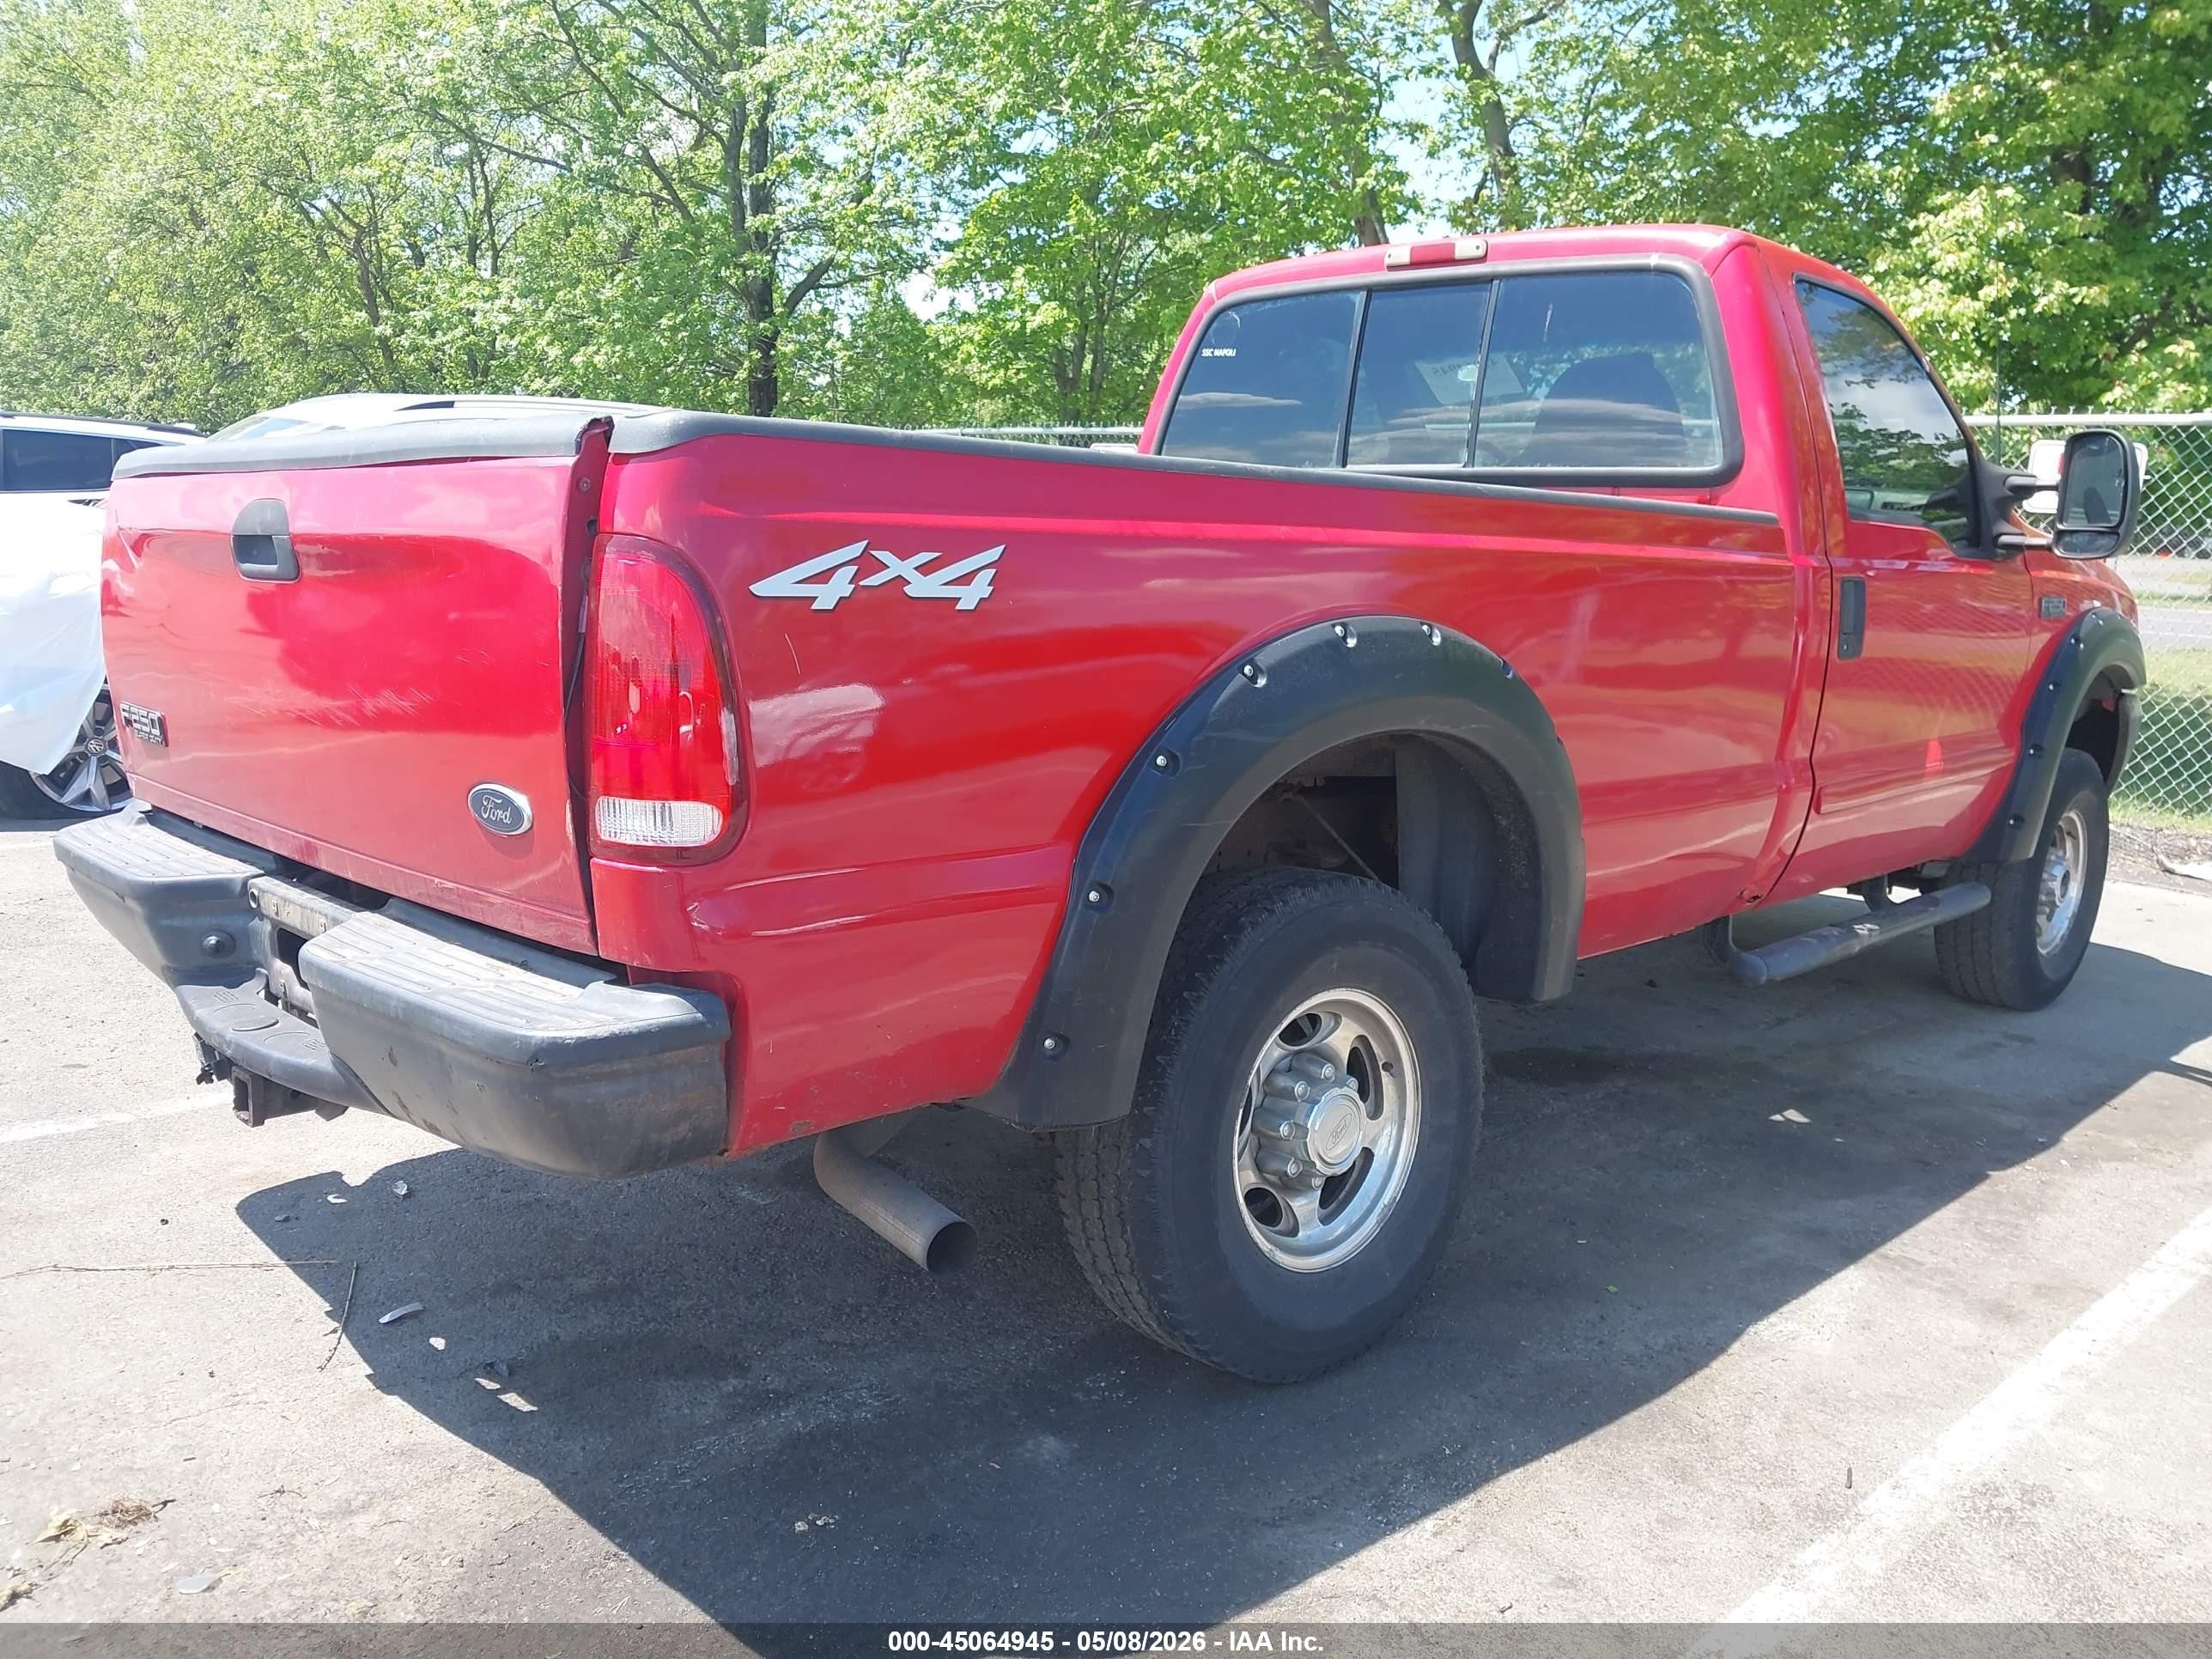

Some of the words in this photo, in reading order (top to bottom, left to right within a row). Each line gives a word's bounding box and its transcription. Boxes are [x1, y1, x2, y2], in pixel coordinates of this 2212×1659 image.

[1214, 348, 1237, 357] NAPOLI
[481, 795, 512, 824] Ford
[1332, 1120, 1347, 1144] Ford
